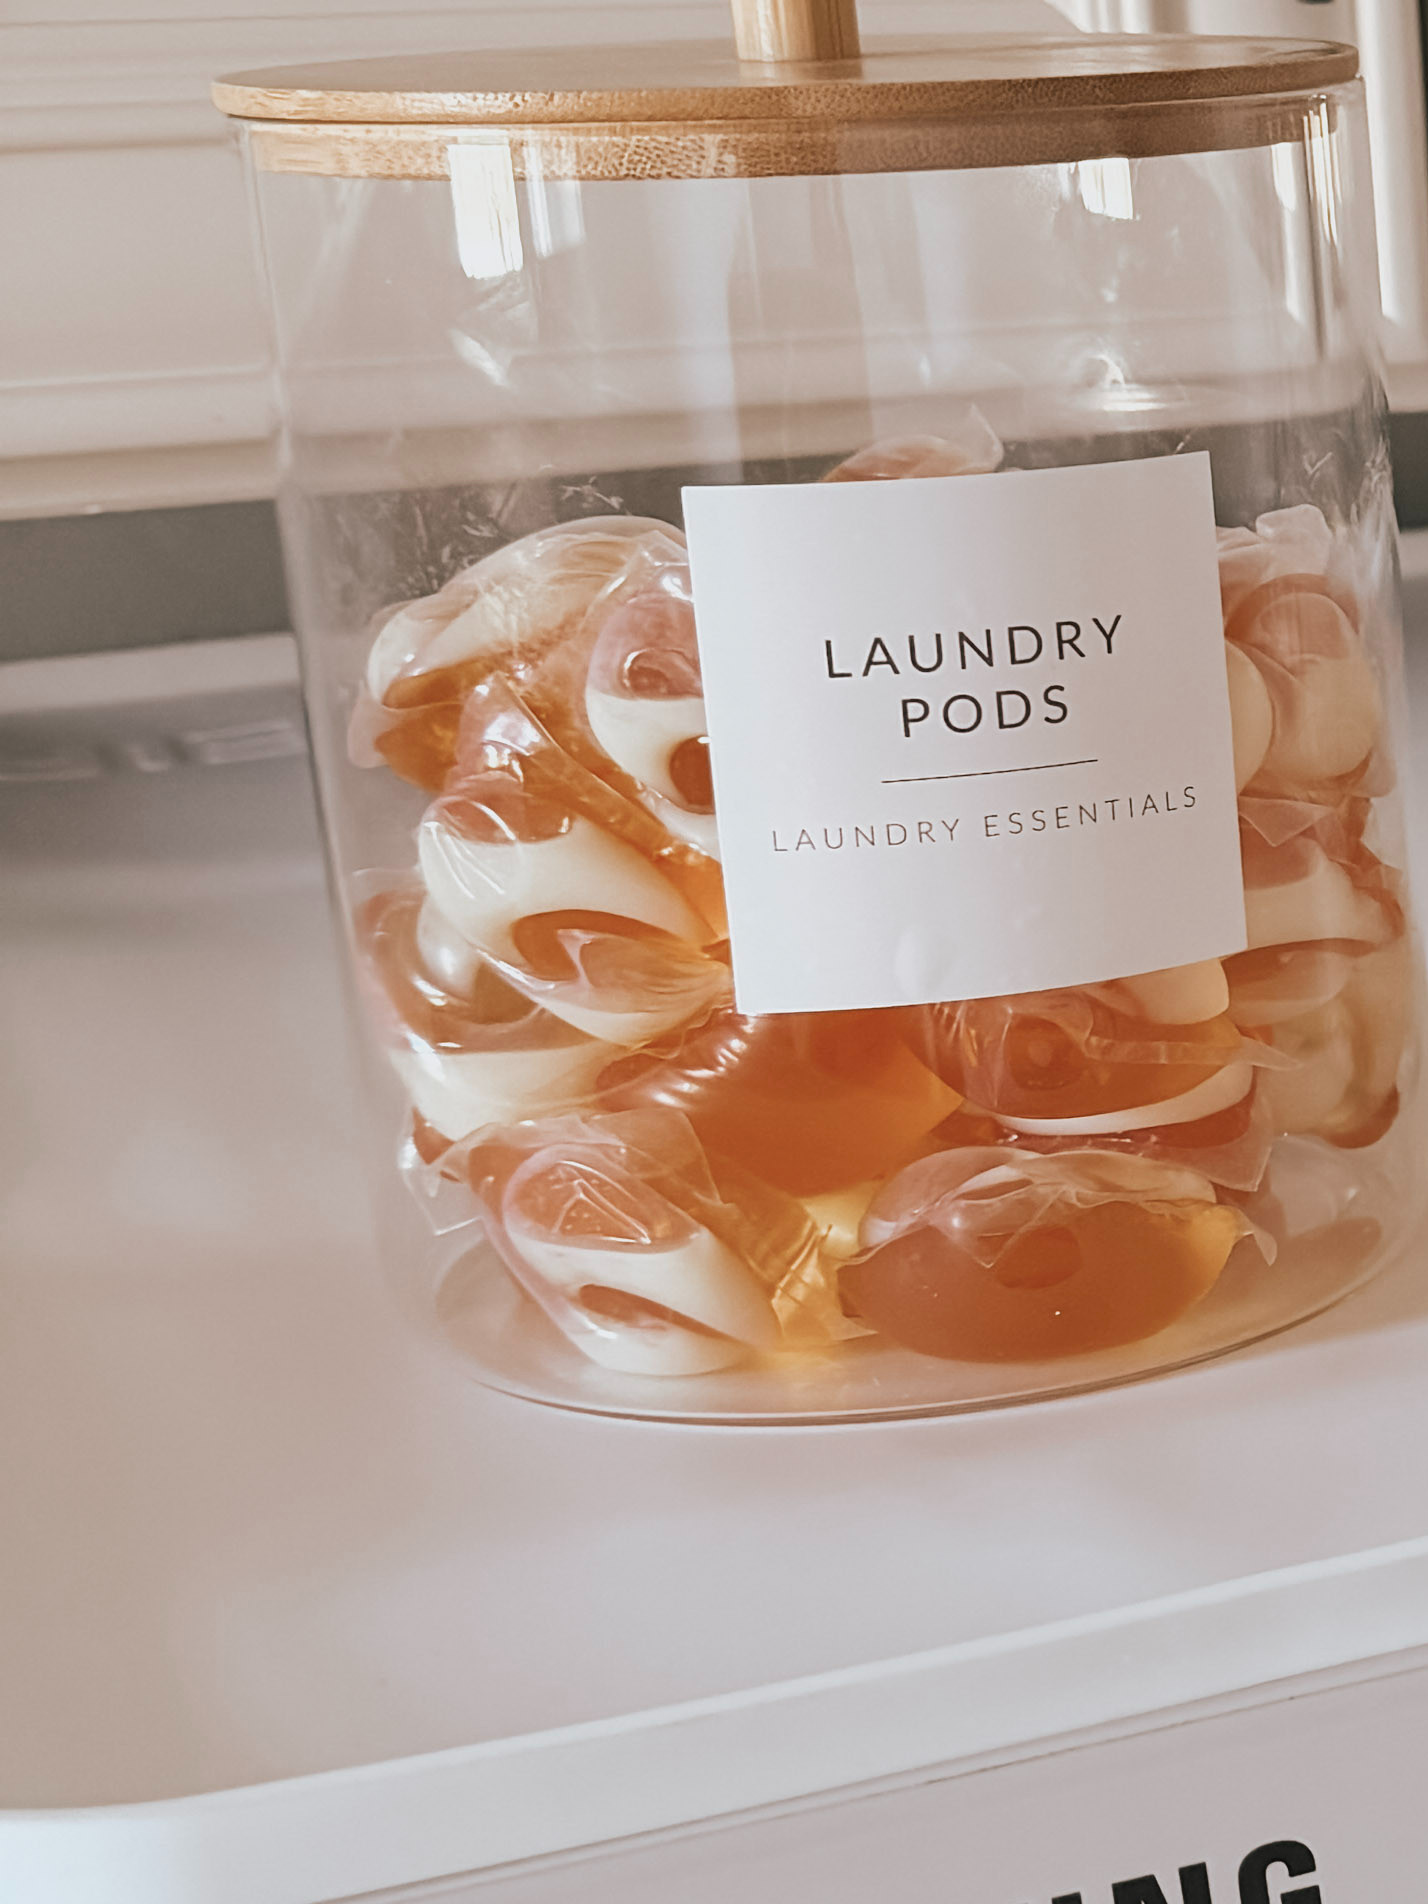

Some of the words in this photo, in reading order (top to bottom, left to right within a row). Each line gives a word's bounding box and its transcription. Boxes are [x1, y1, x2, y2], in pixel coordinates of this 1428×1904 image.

[824, 614, 1123, 679] LAUNDRY
[900, 684, 1070, 739] PODS
[772, 817, 960, 854] LAUNDRY
[983, 785, 1198, 838] ESSENTIALS
